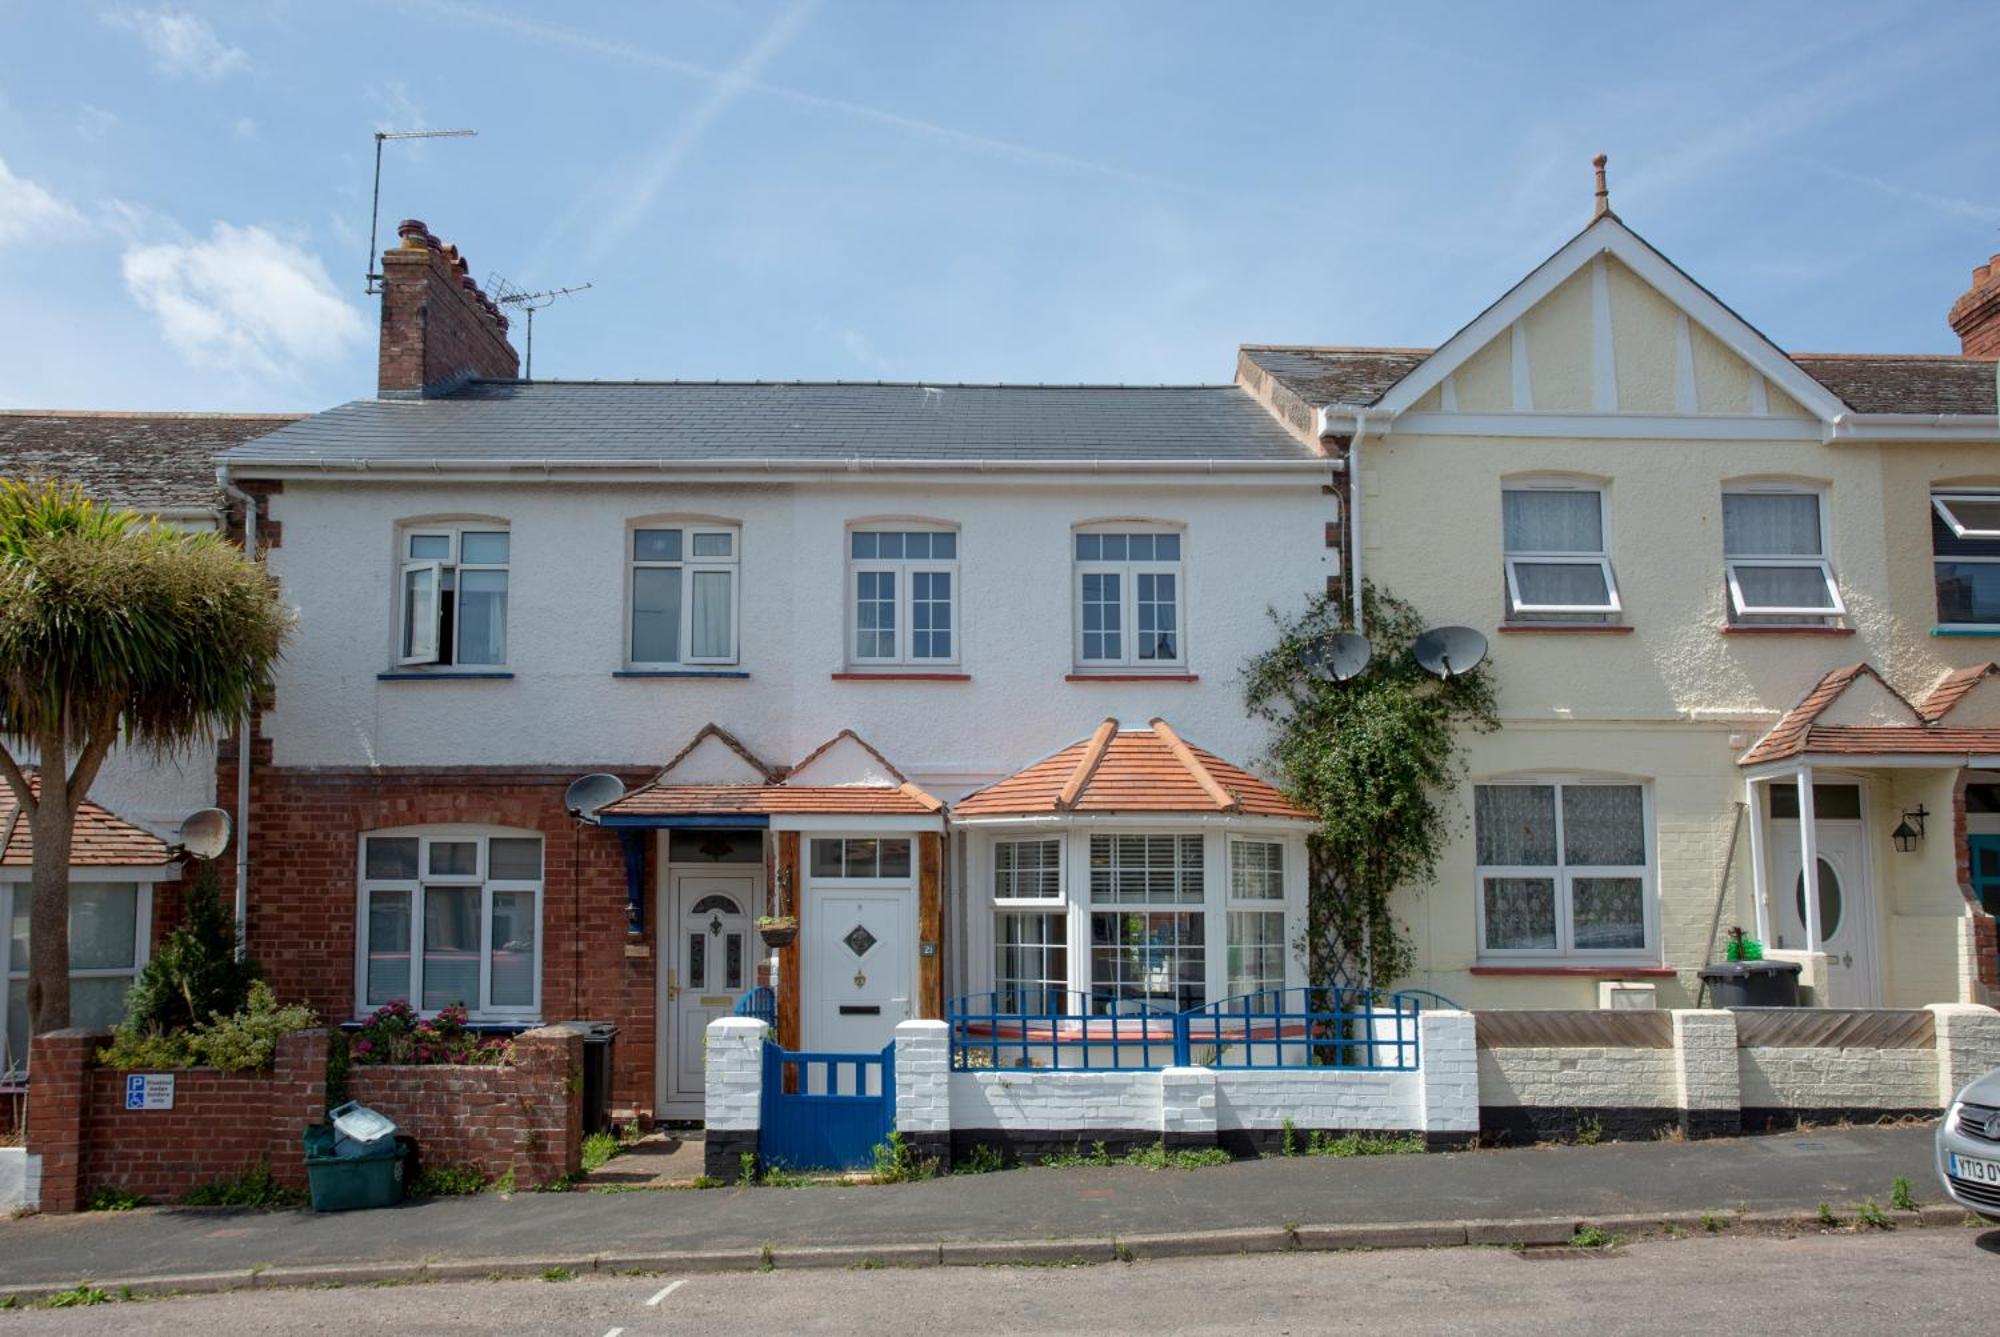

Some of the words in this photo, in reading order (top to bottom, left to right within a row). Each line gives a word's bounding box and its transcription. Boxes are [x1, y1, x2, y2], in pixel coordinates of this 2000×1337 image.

[924, 945, 933, 954] 21
[132, 1078, 142, 1089] P
[1959, 1160, 1984, 1178] YT13
